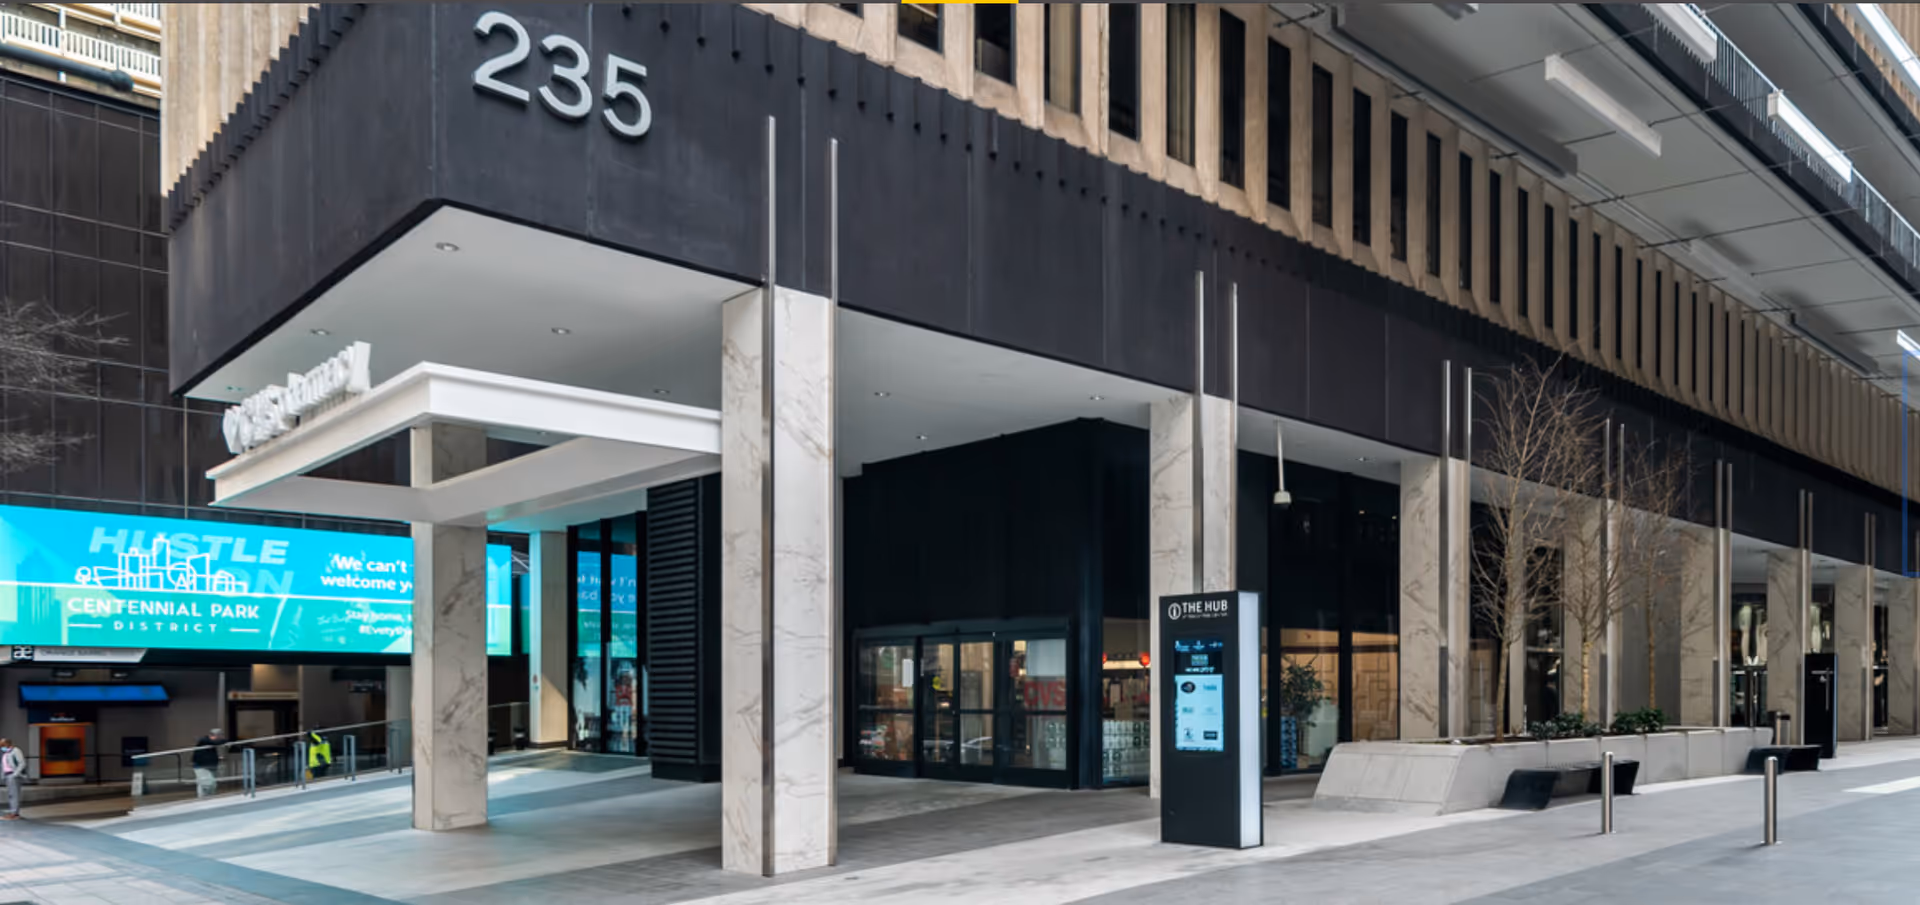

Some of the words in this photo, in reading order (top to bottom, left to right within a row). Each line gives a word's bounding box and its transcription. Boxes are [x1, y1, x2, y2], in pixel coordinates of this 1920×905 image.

[472, 11, 651, 138] 235
[89, 527, 290, 565] HUSTLE
[334, 553, 363, 571] We
[366, 560, 407, 573] can't
[320, 573, 396, 590] welcome
[67, 597, 202, 617] CENTENNIAL
[210, 603, 260, 619] PARK
[1182, 600, 1203, 613] THE
[1204, 599, 1228, 612] HUB
[113, 620, 218, 633] DISTRICT
[1024, 680, 1066, 706] CVS
